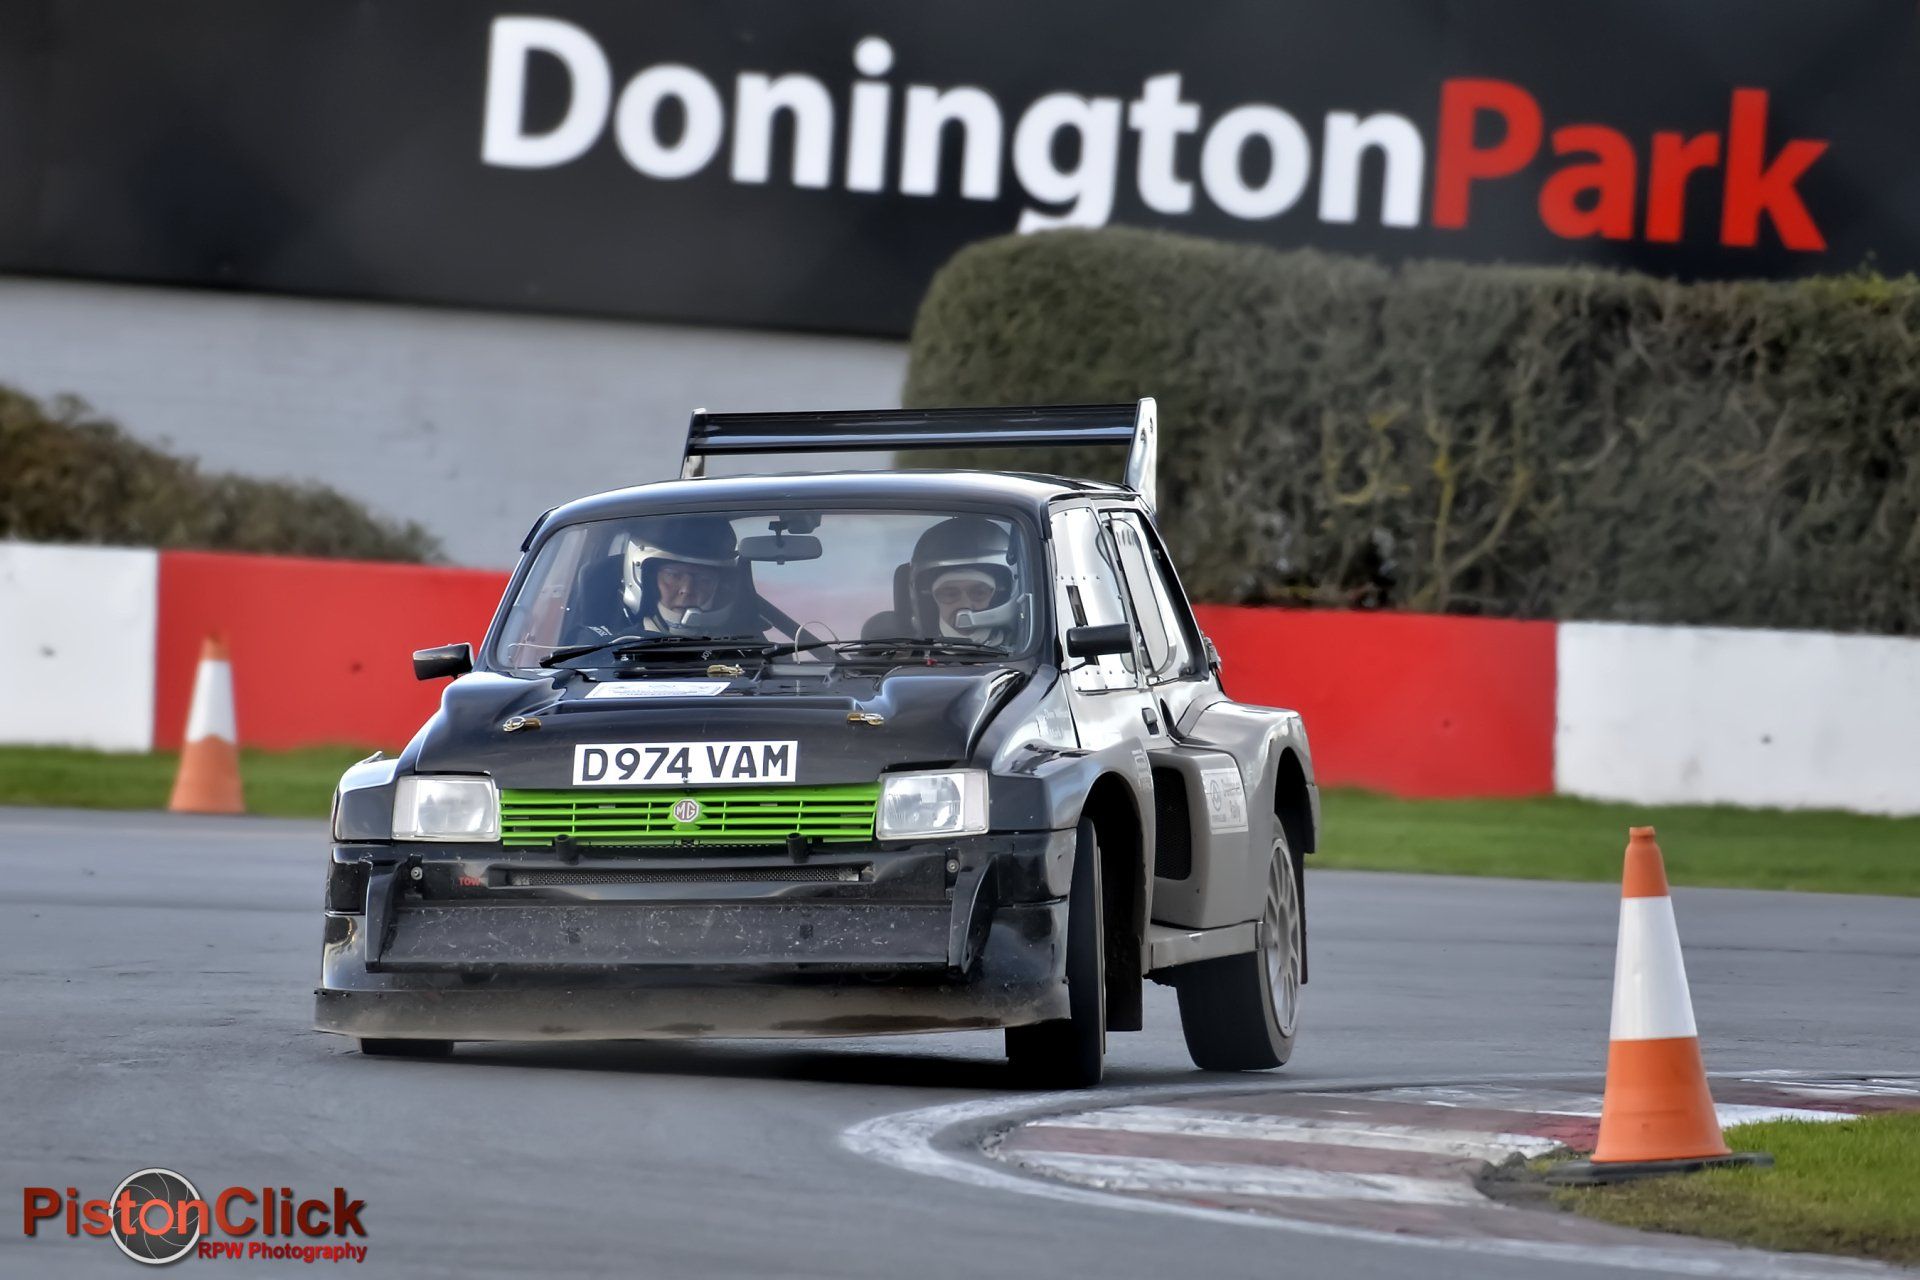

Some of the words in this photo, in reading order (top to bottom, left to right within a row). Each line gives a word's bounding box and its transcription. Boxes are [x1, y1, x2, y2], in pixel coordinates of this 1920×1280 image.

[481, 16, 1830, 251] DoningtonPark
[582, 747, 693, 781] D974
[706, 744, 790, 778] VAM
[676, 801, 696, 820] MG
[458, 876, 481, 886] TOW
